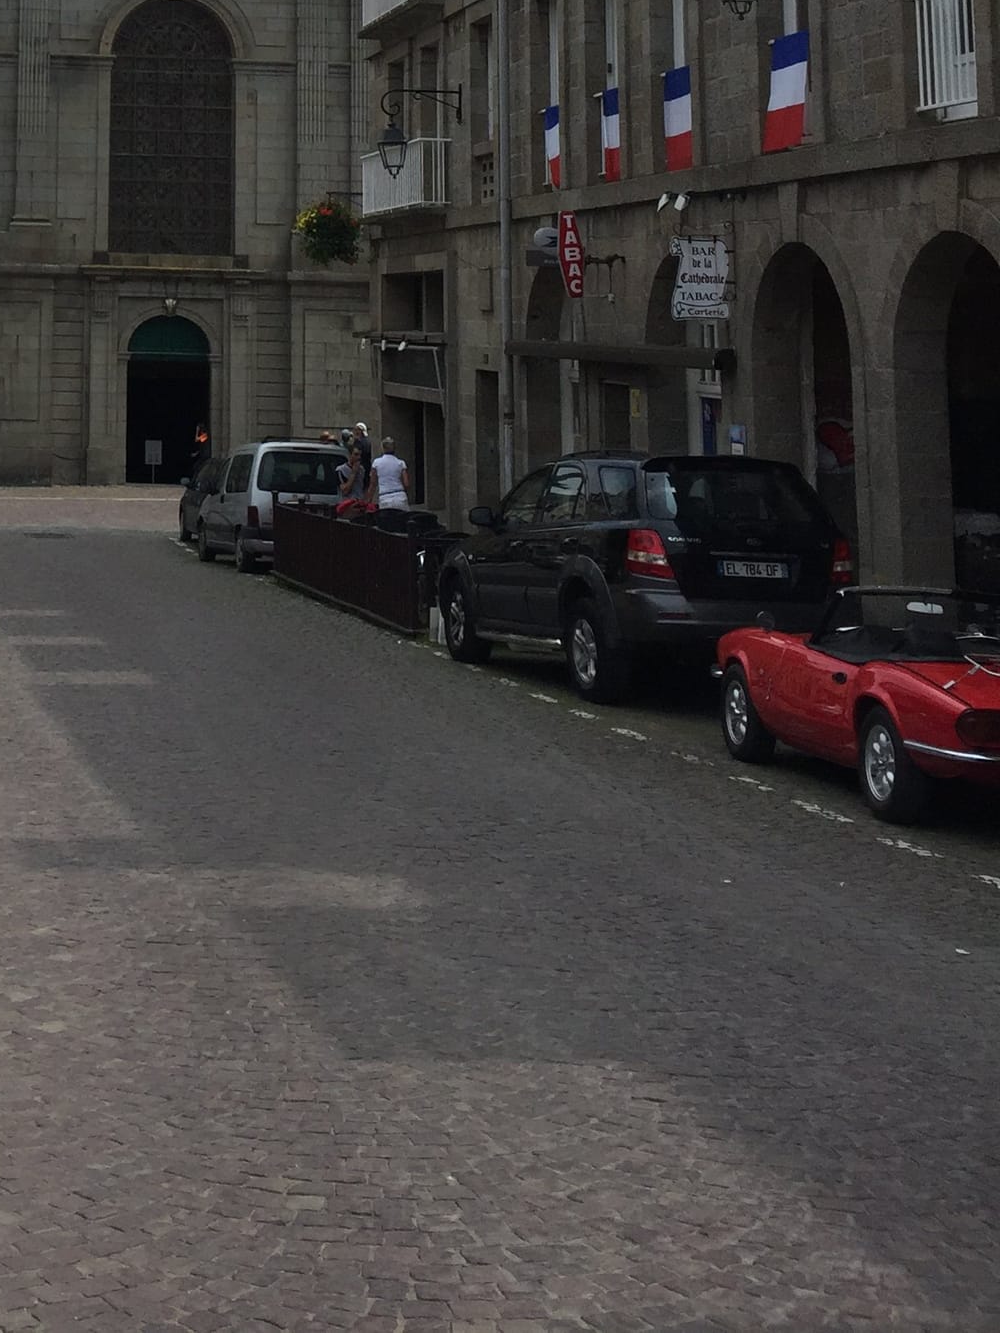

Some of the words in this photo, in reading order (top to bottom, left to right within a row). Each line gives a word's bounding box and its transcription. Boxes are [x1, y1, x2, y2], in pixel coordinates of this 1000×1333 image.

[563, 215, 582, 293] TABAC
[691, 247, 716, 256] BAR
[692, 258, 702, 268] de
[704, 257, 712, 268] la
[680, 291, 719, 301] TABAC
